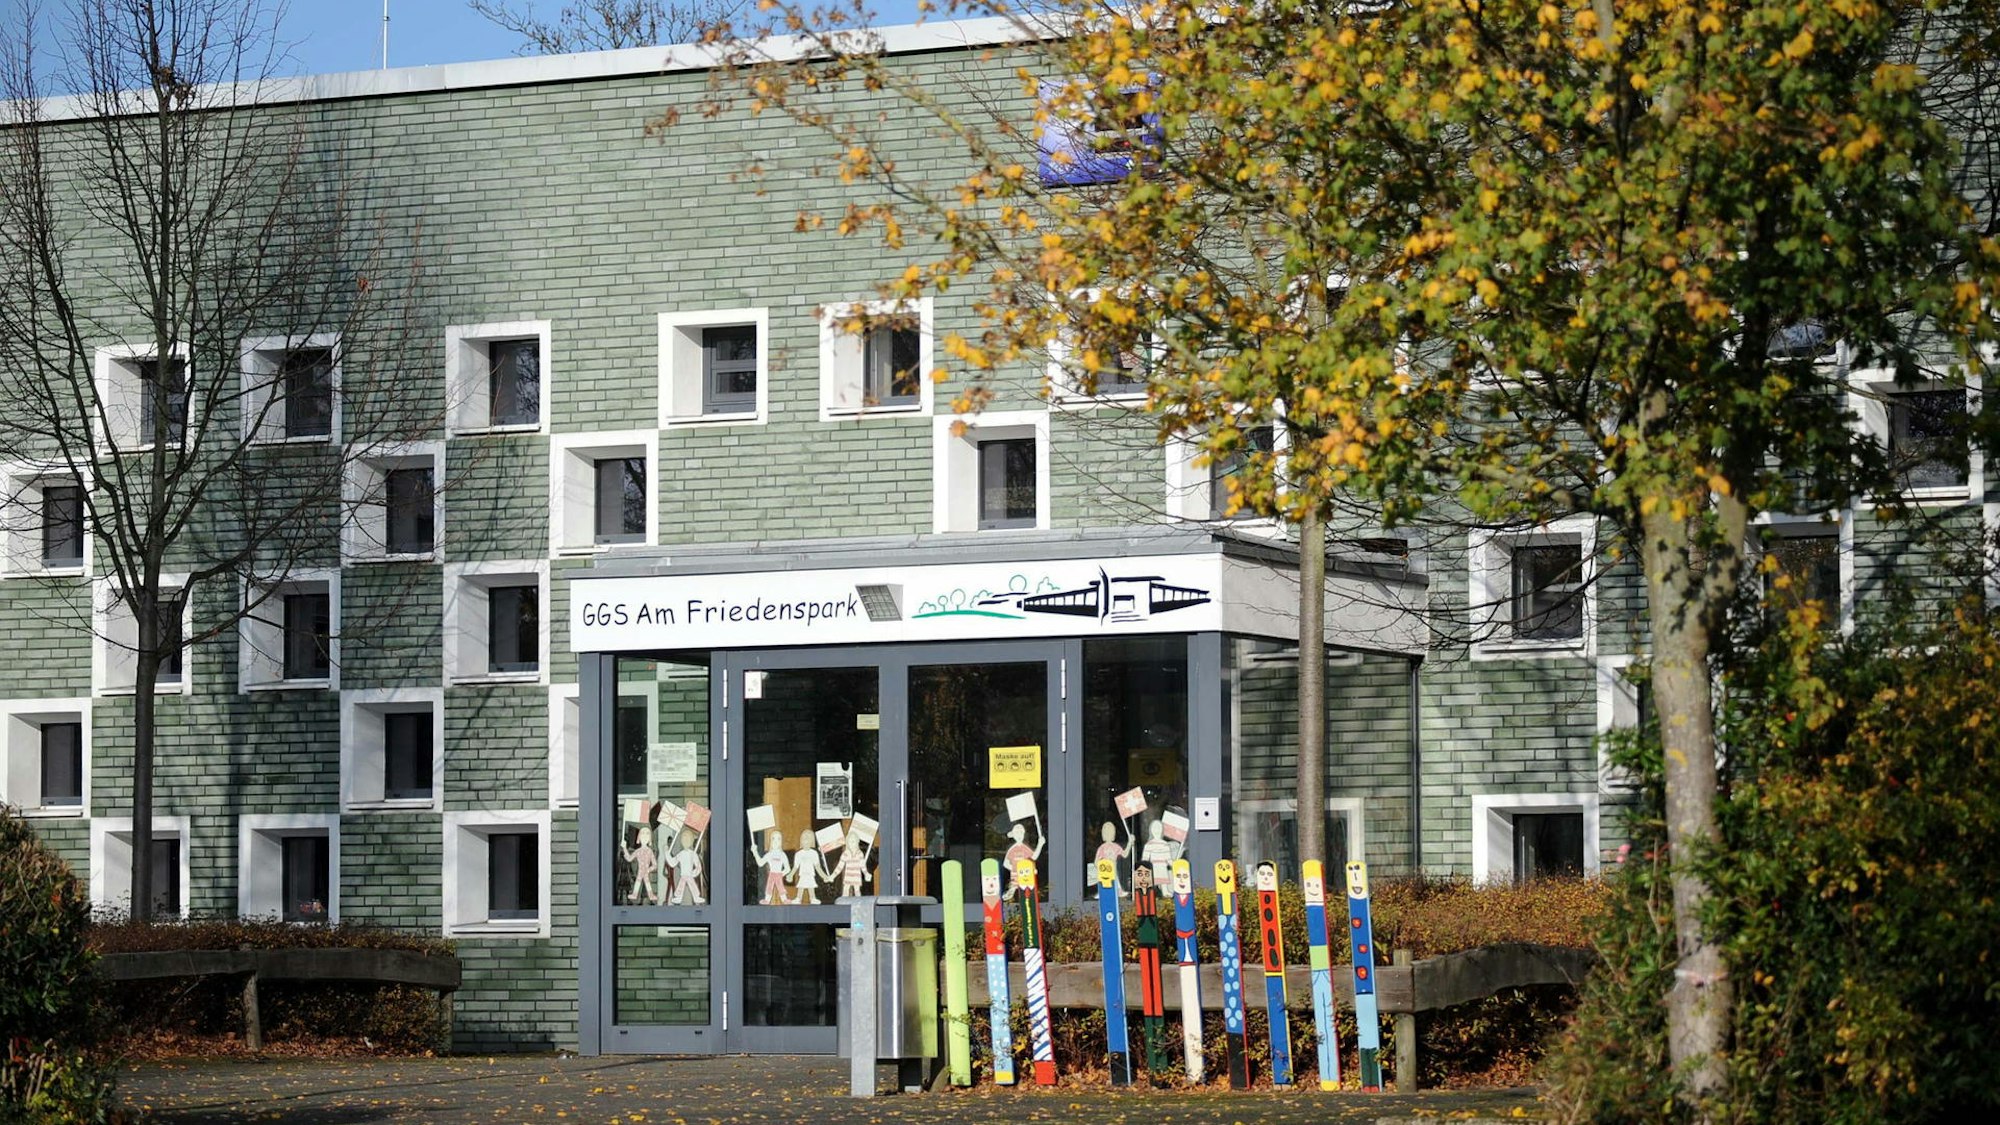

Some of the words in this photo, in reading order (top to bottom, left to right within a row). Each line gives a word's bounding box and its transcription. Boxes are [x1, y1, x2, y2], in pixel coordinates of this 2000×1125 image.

[582, 602, 629, 627] GGS
[636, 603, 675, 625] Am
[687, 592, 857, 627] Friedenspark
